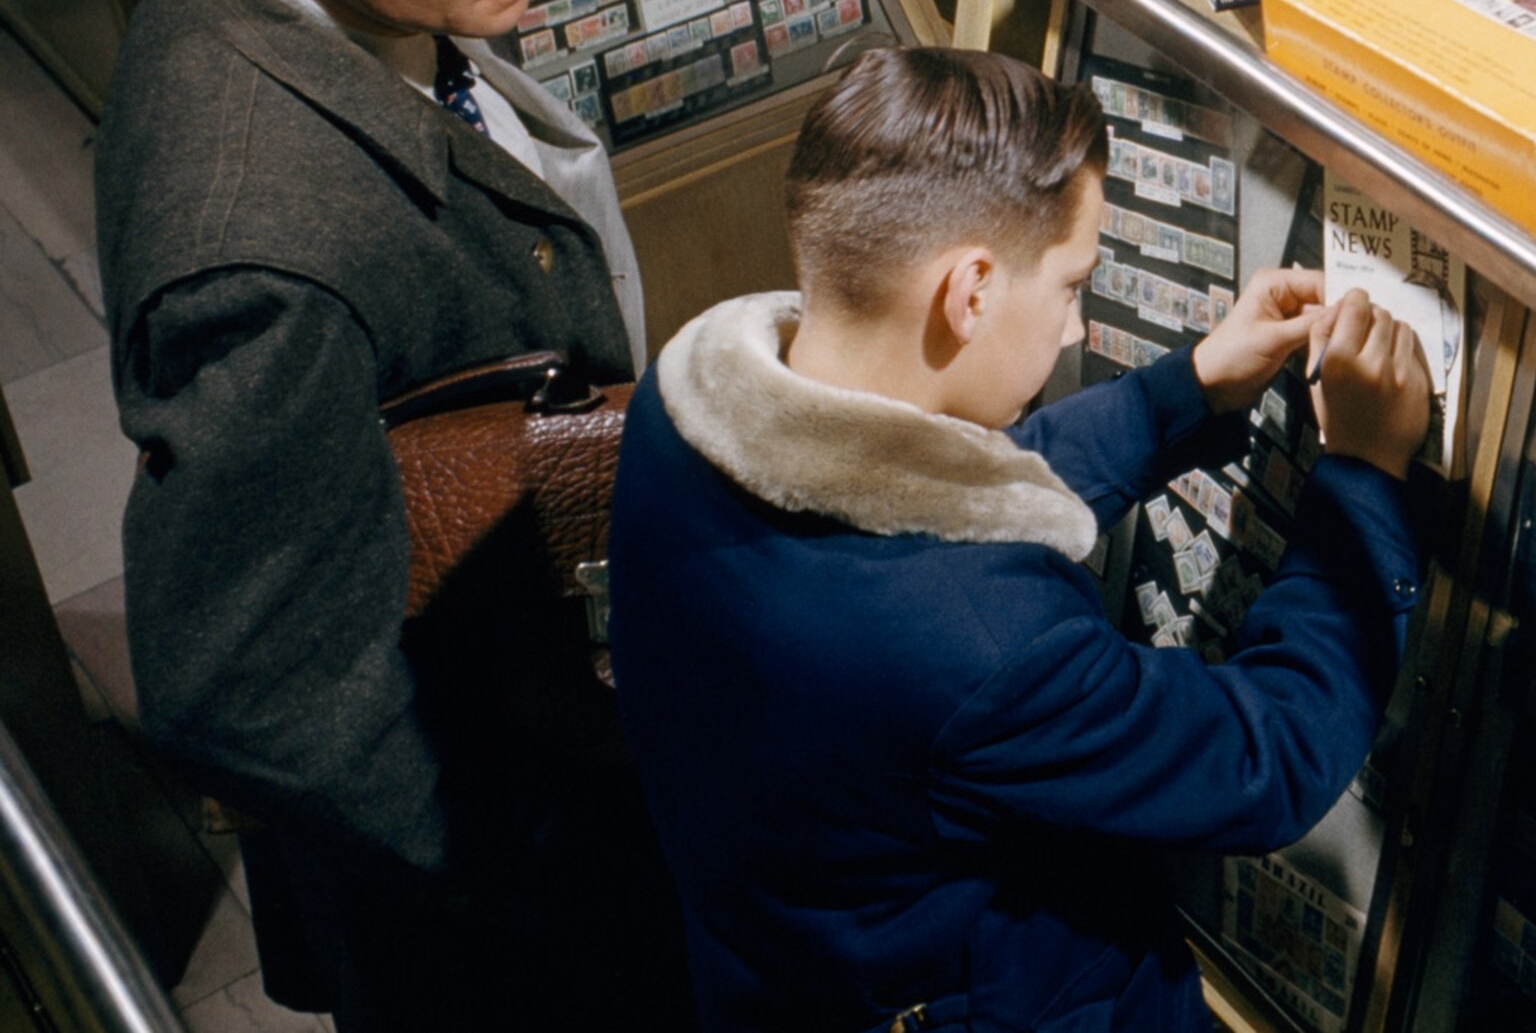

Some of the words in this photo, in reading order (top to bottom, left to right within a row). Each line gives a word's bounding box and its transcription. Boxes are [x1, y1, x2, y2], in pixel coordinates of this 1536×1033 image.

[1330, 201, 1399, 233] STAMP
[1332, 229, 1393, 260] NEWS
[1262, 856, 1327, 909] BRAZIL
